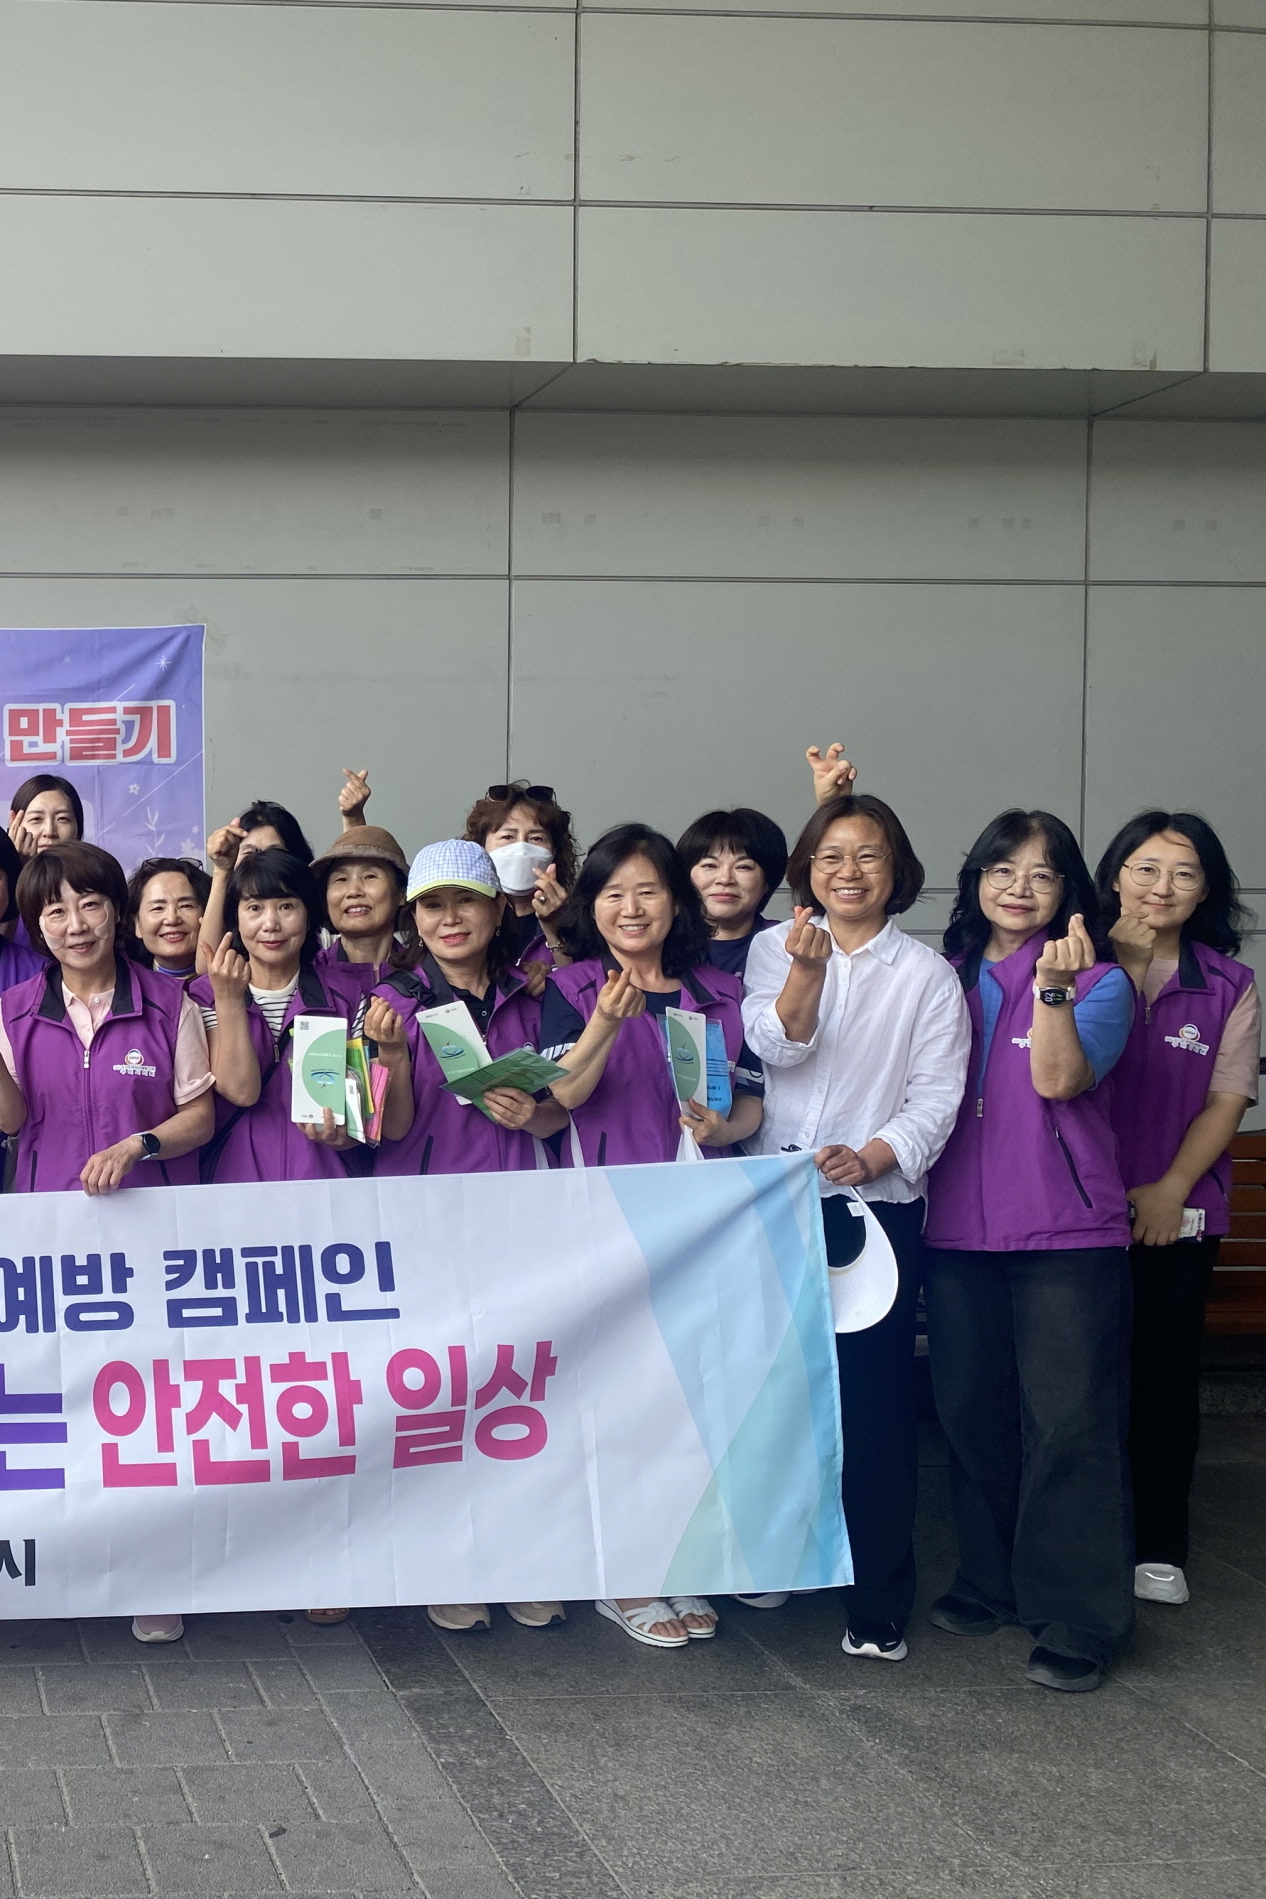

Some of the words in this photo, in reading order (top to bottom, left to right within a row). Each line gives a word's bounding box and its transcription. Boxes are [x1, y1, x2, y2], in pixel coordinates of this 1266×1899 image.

[9, 705, 171, 761] 만들기
[163, 1241, 401, 1329] 캠페인
[92, 1351, 363, 1488] 안전한
[386, 1340, 558, 1469] 일상
